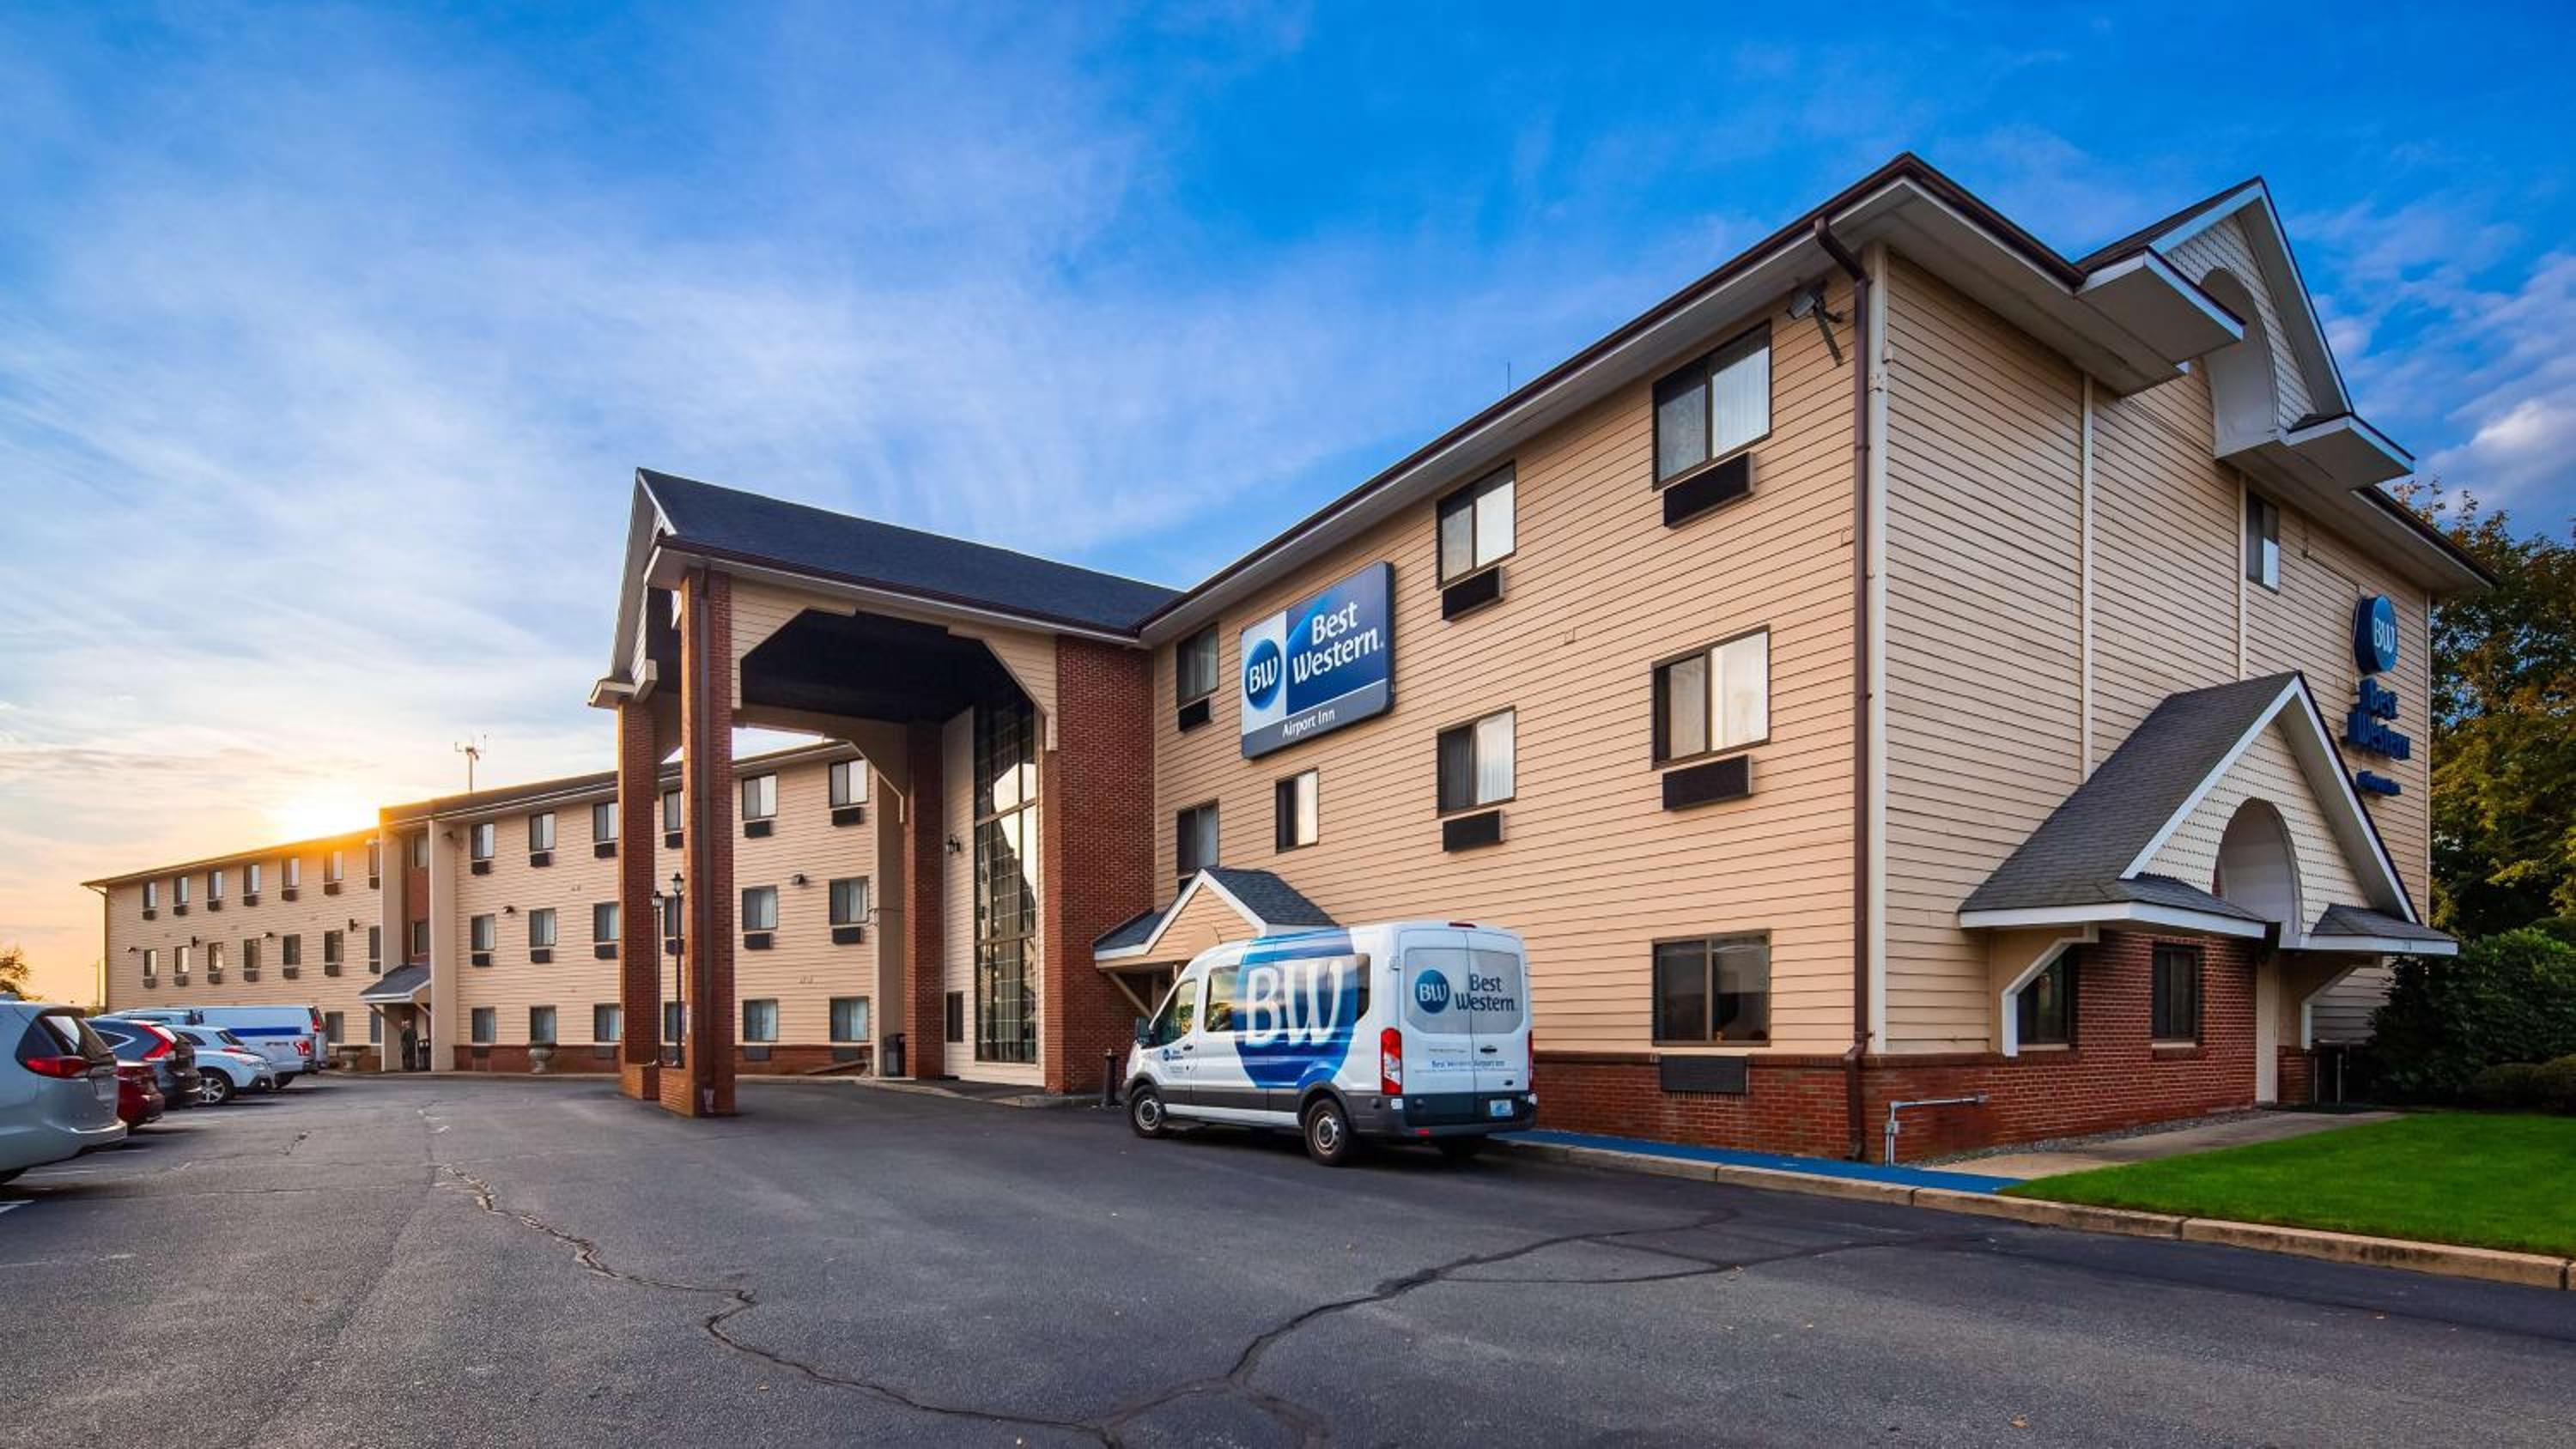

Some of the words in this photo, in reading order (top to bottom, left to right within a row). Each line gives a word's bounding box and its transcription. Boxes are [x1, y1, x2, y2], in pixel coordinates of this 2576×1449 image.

[1312, 601, 1358, 646] Best
[2374, 617, 2395, 654] BW
[1292, 627, 1378, 684] Western
[1249, 657, 1279, 694] BW
[1282, 715, 1316, 738] Airport
[1318, 709, 1335, 725] Inn
[1419, 983, 1448, 1002] BW
[1469, 973, 1502, 992] Best
[1244, 961, 1342, 1047] BW
[1455, 992, 1514, 1011] Western
